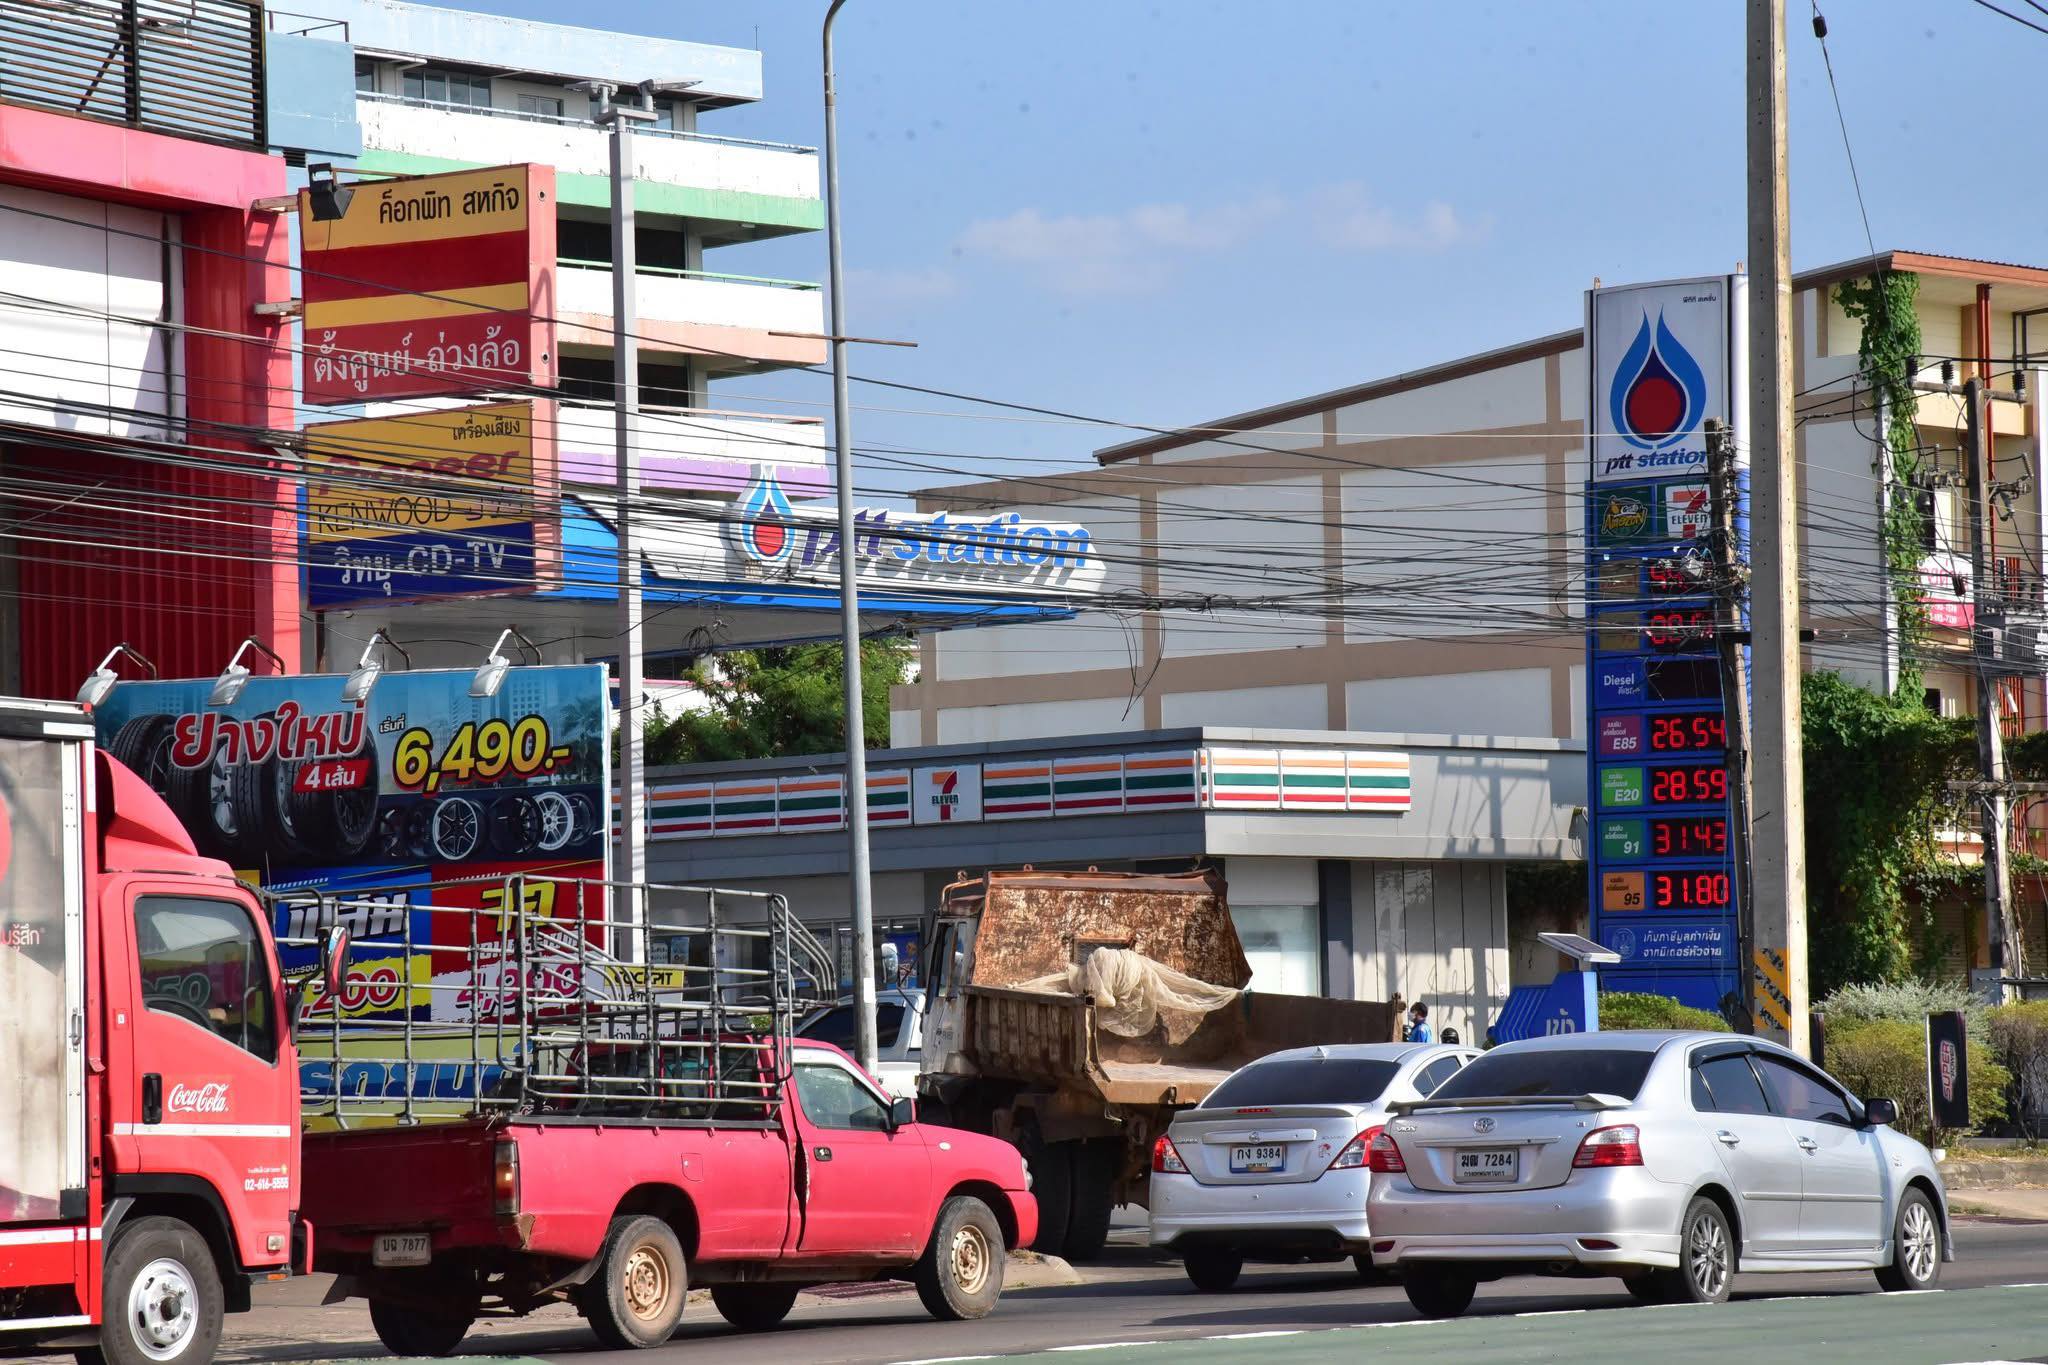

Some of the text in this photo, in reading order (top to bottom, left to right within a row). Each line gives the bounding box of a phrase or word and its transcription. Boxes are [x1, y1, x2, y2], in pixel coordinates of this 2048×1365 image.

[379, 182, 520, 225] ค็อกพิท สหกิจ
[452, 414, 520, 441] เครื่องเสียง
[1604, 451, 1634, 475] ptt
[318, 495, 451, 534] KENWOOD
[891, 510, 1092, 569] station
[1603, 672, 1635, 687] Diesel
[171, 699, 368, 769] ยางใหม่
[379, 713, 406, 734] เริ่มที่
[393, 714, 572, 796] 6,490.-
[1613, 736, 1637, 751] E85
[304, 765, 355, 789] 4 เส้น
[1615, 789, 1640, 802] E20
[1623, 840, 1640, 854] 91
[1623, 892, 1640, 906] 95
[1657, 874, 1730, 906] 31.80
[1256, 1147, 1281, 1160] 9384
[1484, 1153, 1513, 1167] 7284
